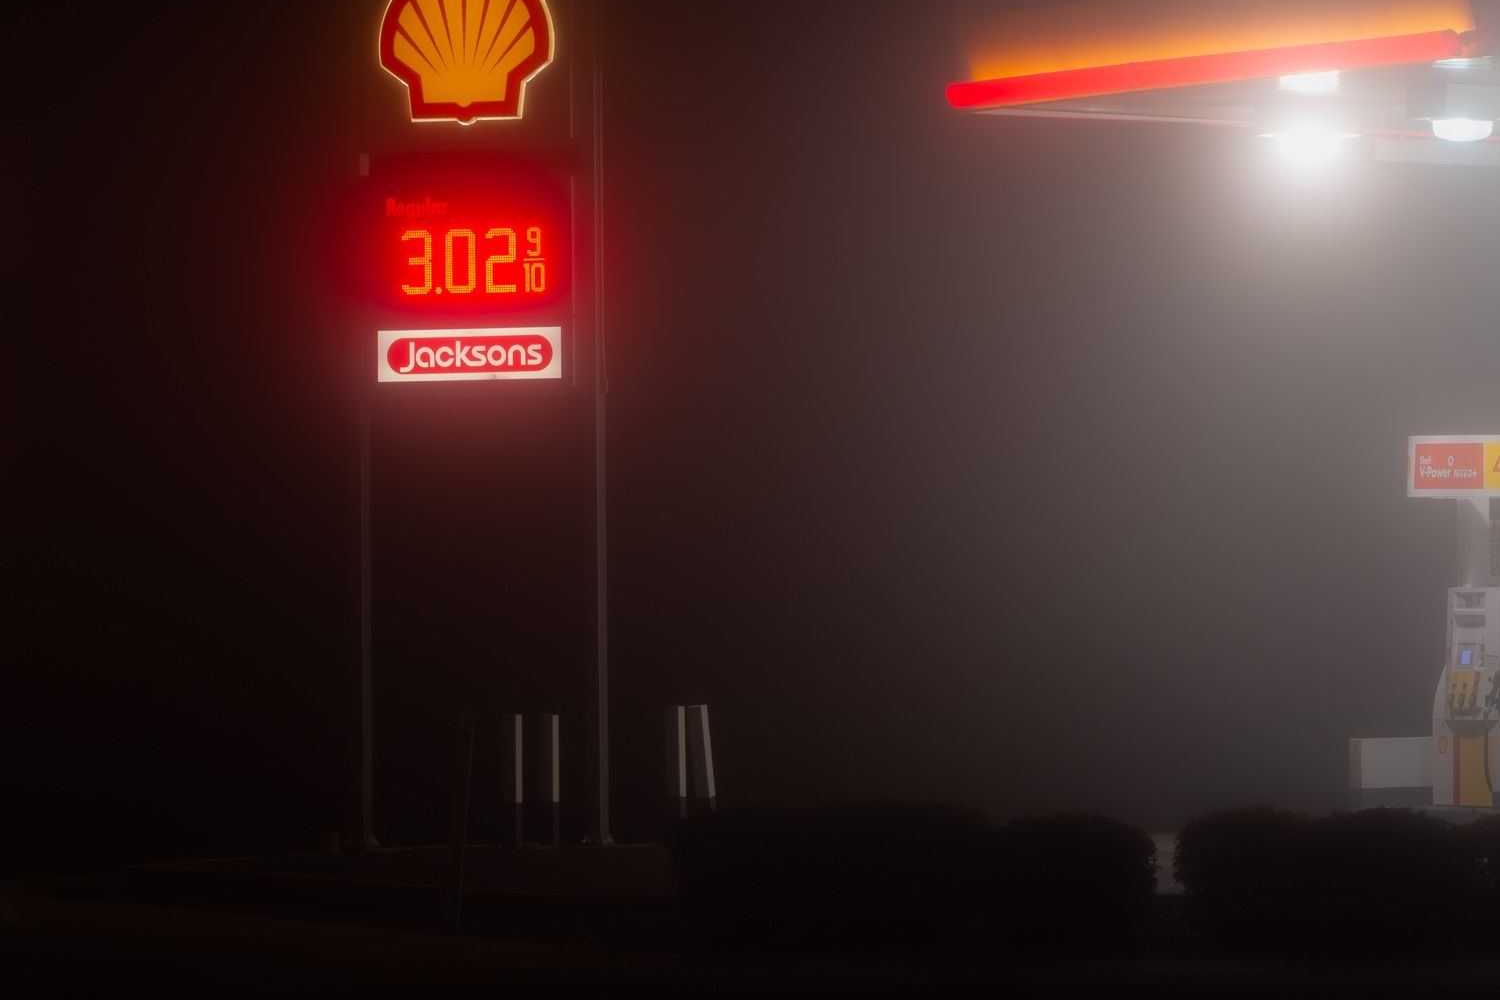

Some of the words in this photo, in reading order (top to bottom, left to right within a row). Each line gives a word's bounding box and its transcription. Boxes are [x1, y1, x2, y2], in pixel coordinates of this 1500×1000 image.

[386, 197, 448, 220] Regular
[526, 226, 542, 257] 9
[401, 227, 517, 295] 3.02
[523, 262, 547, 293] 10
[400, 340, 543, 374] Jacksons
[1419, 466, 1451, 478] V-Power
